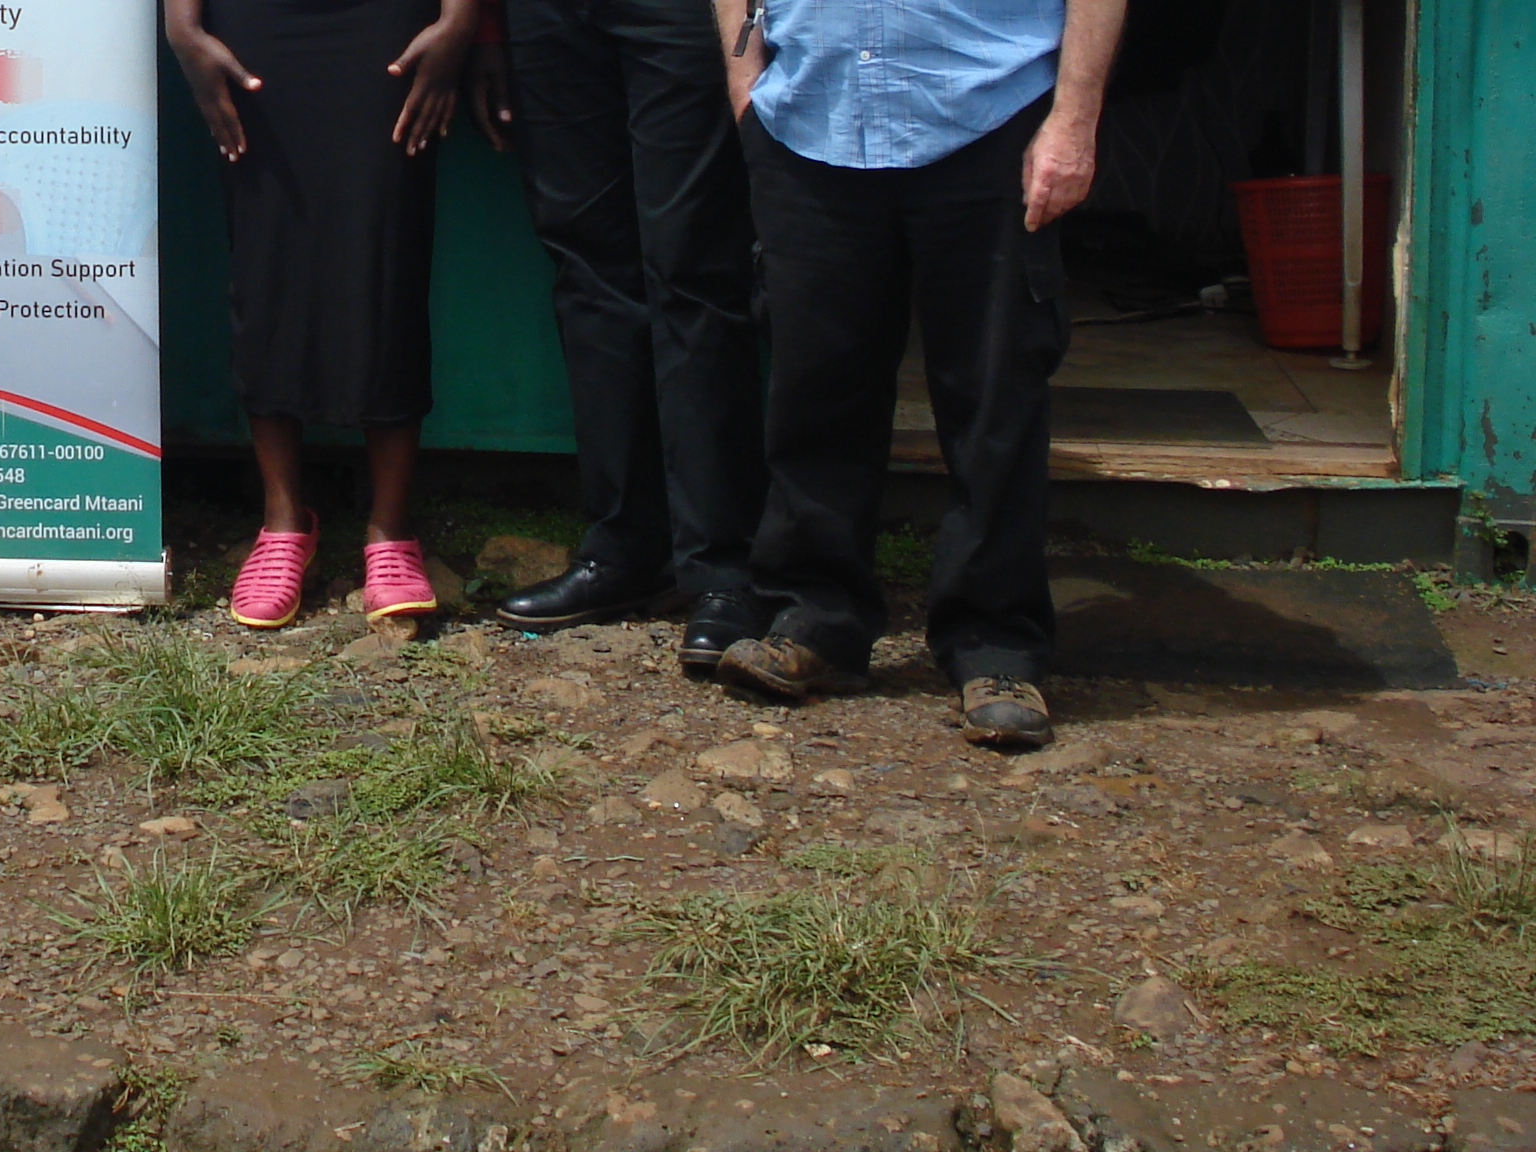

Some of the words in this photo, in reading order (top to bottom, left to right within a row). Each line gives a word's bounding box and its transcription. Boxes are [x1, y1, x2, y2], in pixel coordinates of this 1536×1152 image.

[52, 259, 134, 282] Support
[0, 445, 104, 460] 67611-00100
[85, 495, 142, 511] Mtaani
